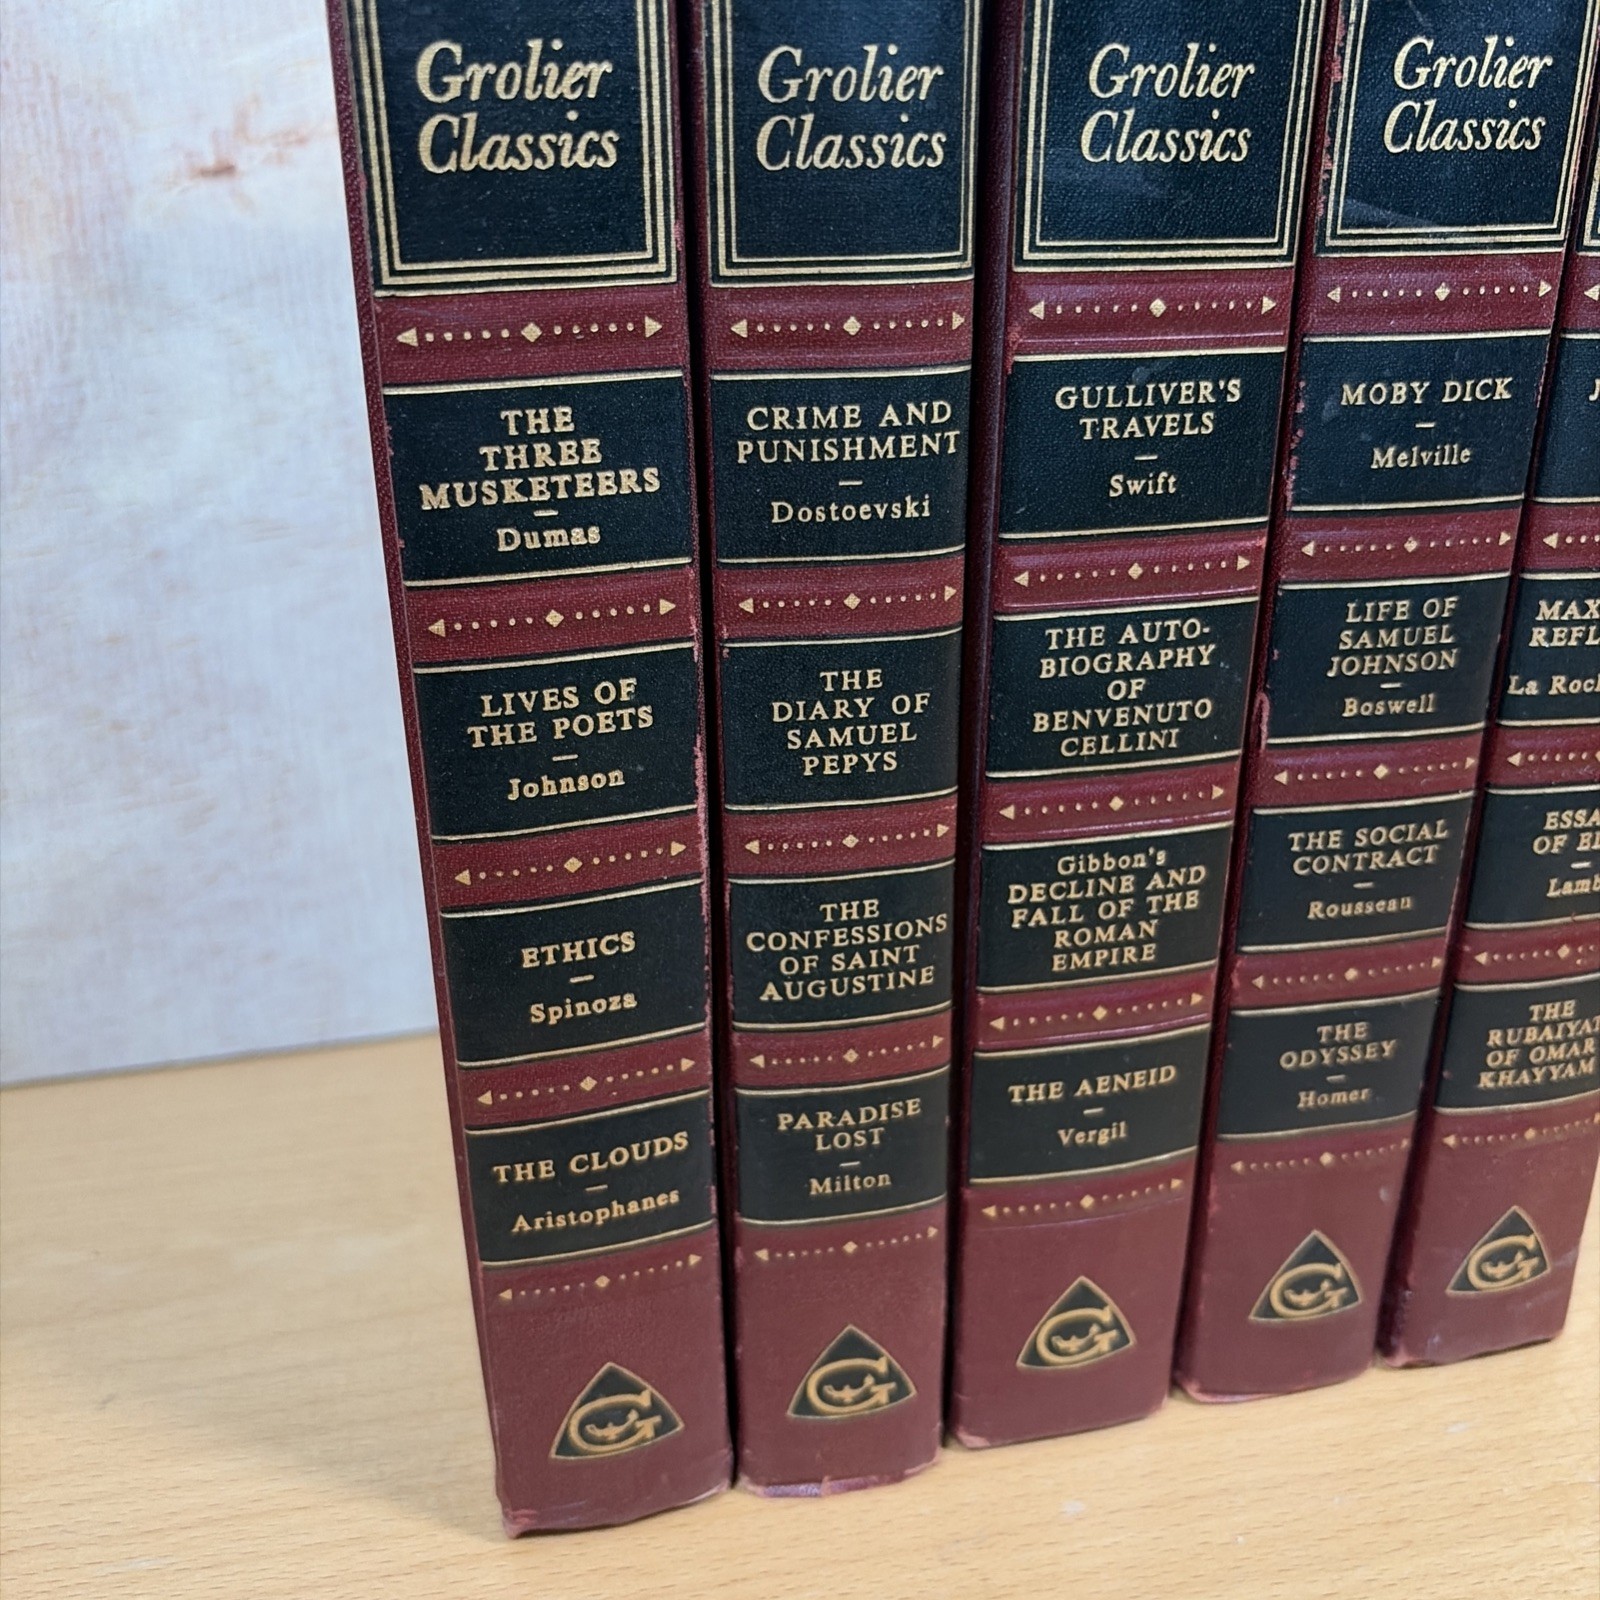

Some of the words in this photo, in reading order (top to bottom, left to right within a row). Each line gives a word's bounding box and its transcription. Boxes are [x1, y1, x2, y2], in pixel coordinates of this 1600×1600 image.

[416, 39, 612, 103] Grolier
[758, 44, 944, 103] Grolier
[1089, 43, 1255, 98] Grolier
[1394, 35, 1553, 89] Grolier
[1081, 108, 1251, 163] Classics
[1384, 99, 1546, 153] Classics
[419, 110, 619, 173] Classics
[757, 113, 946, 170] Classics
[1055, 379, 1240, 409] GULLIVER'S
[1341, 382, 1429, 405] MOBY
[1442, 377, 1512, 402] DICK
[502, 406, 574, 435] THE
[747, 405, 861, 430] CRIME
[879, 401, 951, 427] AND
[1080, 412, 1214, 439] TRAVELS
[479, 438, 602, 471] THREE
[738, 431, 960, 463] PUNISHMENT
[1371, 444, 1471, 468] Melville
[419, 468, 660, 510] MUSKETEERS
[1110, 472, 1176, 497] Swift
[771, 494, 930, 523] Dostoevski
[497, 526, 600, 551] Dumas
[1346, 600, 1410, 622] LIFE
[1423, 597, 1458, 618] OF
[1045, 626, 1105, 650] THE
[1119, 618, 1210, 645] AUTO-
[1339, 624, 1454, 649] SAMUEL
[1040, 644, 1215, 678] BIOGRAPHY
[1327, 649, 1457, 677] JOHNSON
[820, 669, 882, 691] THE
[1108, 678, 1146, 700] OF
[1508, 676, 1539, 695] La
[481, 687, 580, 718] LIVES
[595, 678, 637, 704] OF
[772, 697, 874, 722] DIARY
[892, 693, 930, 714] OF
[1342, 693, 1434, 717] Boswell
[467, 722, 537, 747] THE
[552, 706, 653, 739] POETS
[1033, 699, 1212, 733] BENVENUTO
[788, 722, 917, 749] SAMUEL
[1061, 728, 1179, 756] CELLINI
[802, 751, 897, 775] PEPYS
[508, 770, 625, 800] Johnson
[1288, 830, 1342, 851] THE
[1354, 819, 1448, 847] SOCIAL
[1533, 834, 1568, 854] OF
[1058, 847, 1166, 875] Gibbon's
[1293, 845, 1438, 875] CONTRACT
[1008, 875, 1134, 904] DECLINE
[1146, 865, 1206, 890] AND
[820, 899, 879, 922] THE
[1012, 905, 1084, 928] FALL
[1098, 898, 1134, 920] OF
[1147, 890, 1199, 914] THE
[1308, 897, 1412, 919] Rousseau
[747, 914, 947, 952] CONFESSIONS
[1055, 919, 1158, 948] ROMAN
[522, 931, 635, 968] ETHICS
[780, 955, 818, 975] OF
[832, 945, 919, 971] SAINT
[1053, 943, 1156, 971] EMPIRE
[760, 965, 934, 1002] AUGUSTINE
[531, 993, 637, 1024] Spinoza
[1530, 1000, 1575, 1022] THE
[1317, 1022, 1367, 1043] THE
[1280, 1040, 1396, 1069] ODYSSEY
[1487, 1049, 1521, 1068] OF
[1529, 1038, 1595, 1065] OMAR
[1008, 1081, 1063, 1103] THE
[1074, 1065, 1176, 1097] AENEID
[1478, 1057, 1595, 1088] KHAYYAM
[1297, 1089, 1370, 1108] Homer
[778, 1098, 921, 1131] PARADISE
[816, 1127, 884, 1150] LOST
[1058, 1121, 1126, 1145] Vergil
[493, 1160, 555, 1182] THE
[569, 1131, 688, 1173] CLOUDS
[810, 1174, 891, 1195] Milton
[512, 1190, 679, 1232] Aristophanes
